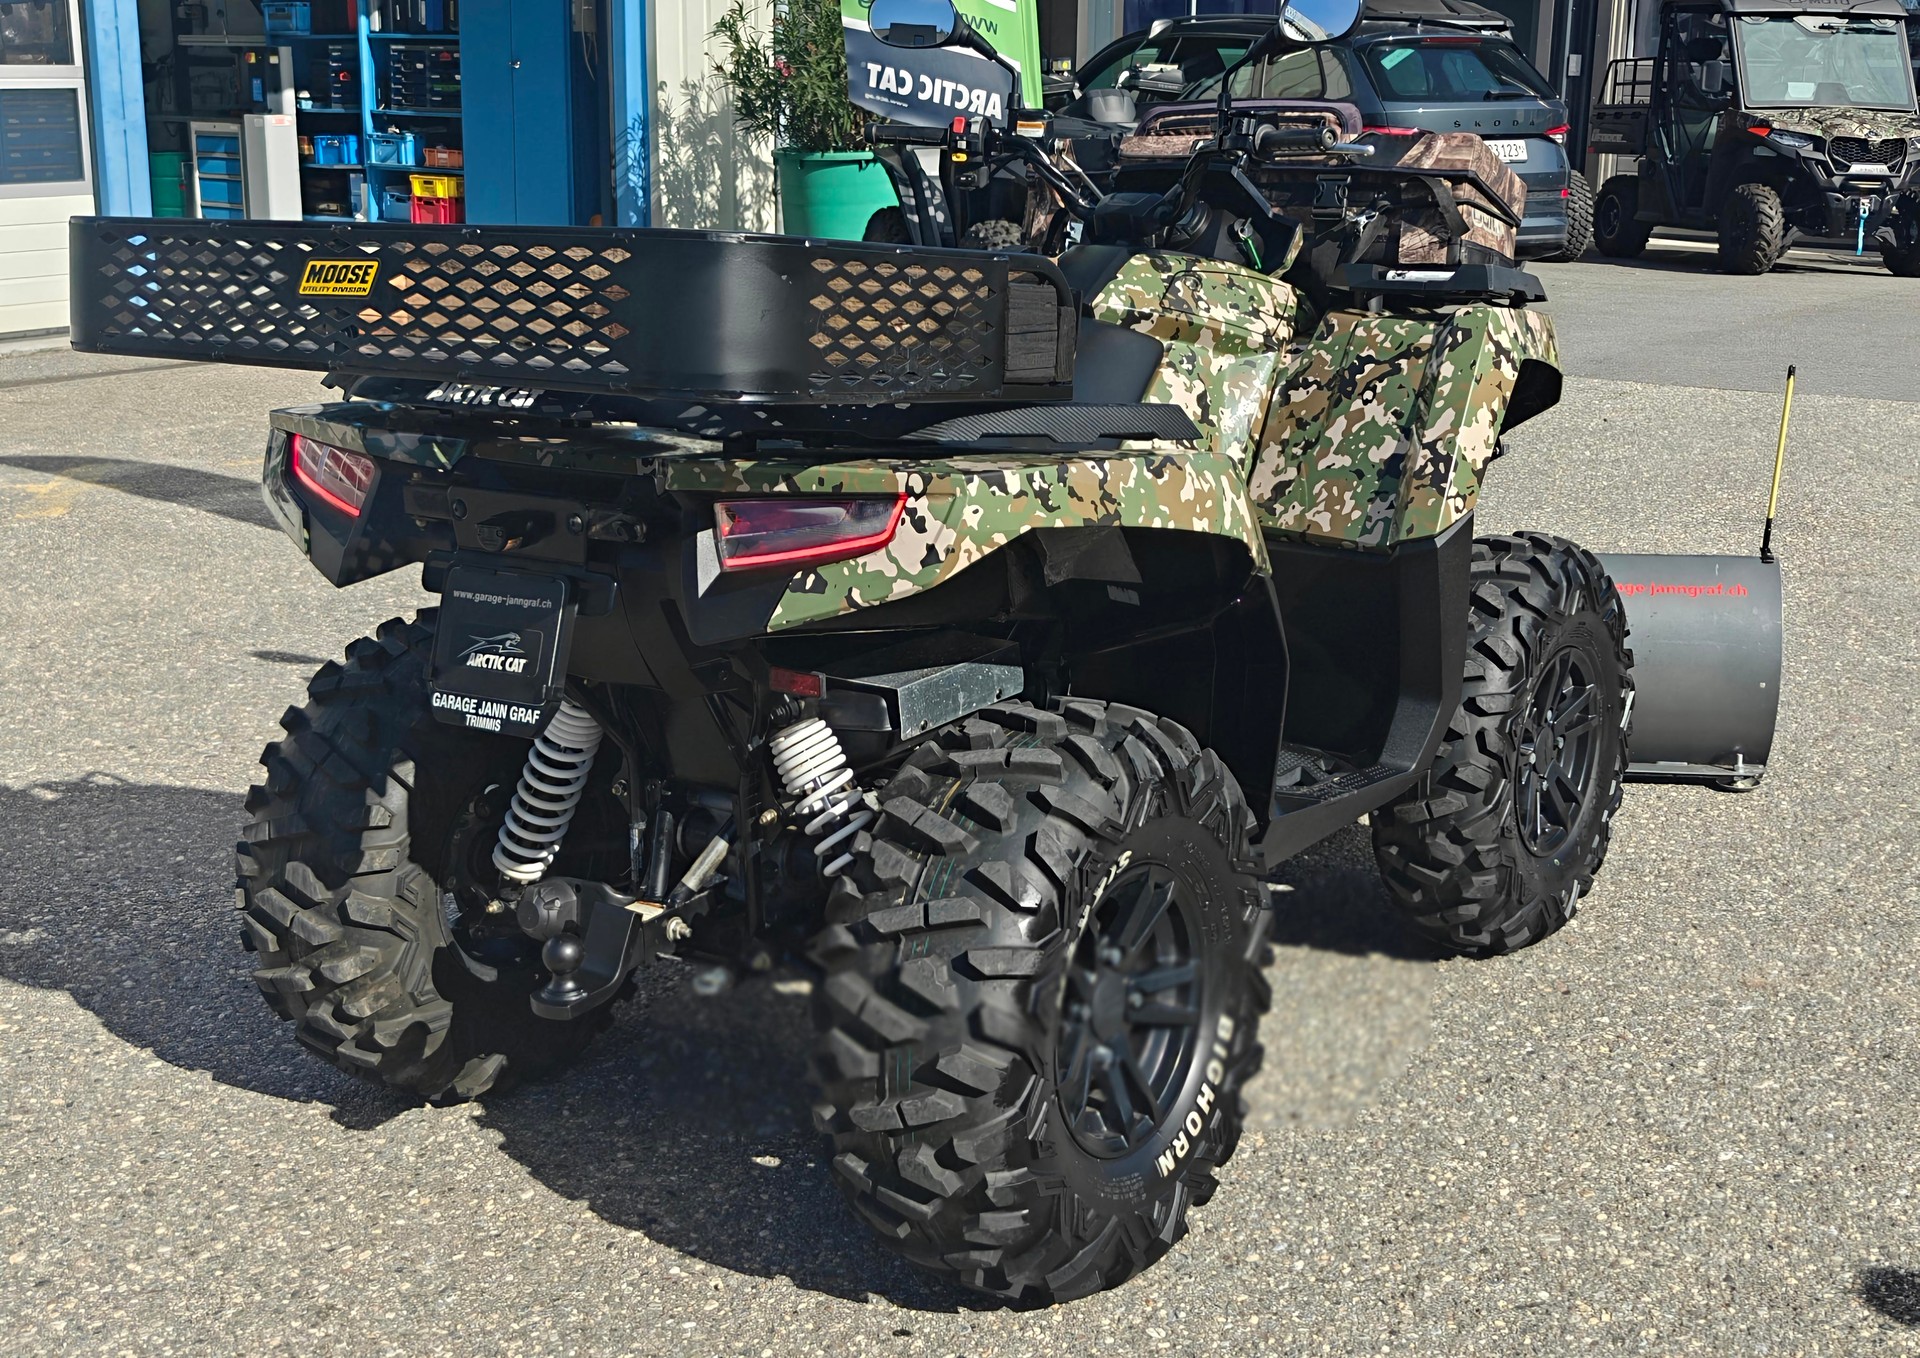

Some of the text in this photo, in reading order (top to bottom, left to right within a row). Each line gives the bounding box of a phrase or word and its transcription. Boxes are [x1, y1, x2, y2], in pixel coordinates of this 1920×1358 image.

[305, 264, 375, 285] MOOSE
[425, 381, 546, 409] ARCTIC CAT
[453, 589, 552, 609] www.garage-janngraf.ch
[1615, 582, 1748, 598] age-janngraf.ch
[466, 652, 528, 673] ARCTIC CAT
[432, 692, 541, 725] GARAGE JANN GRAF
[465, 714, 502, 732] TRIMMIS
[1158, 1013, 1235, 1178] BIGHORN
